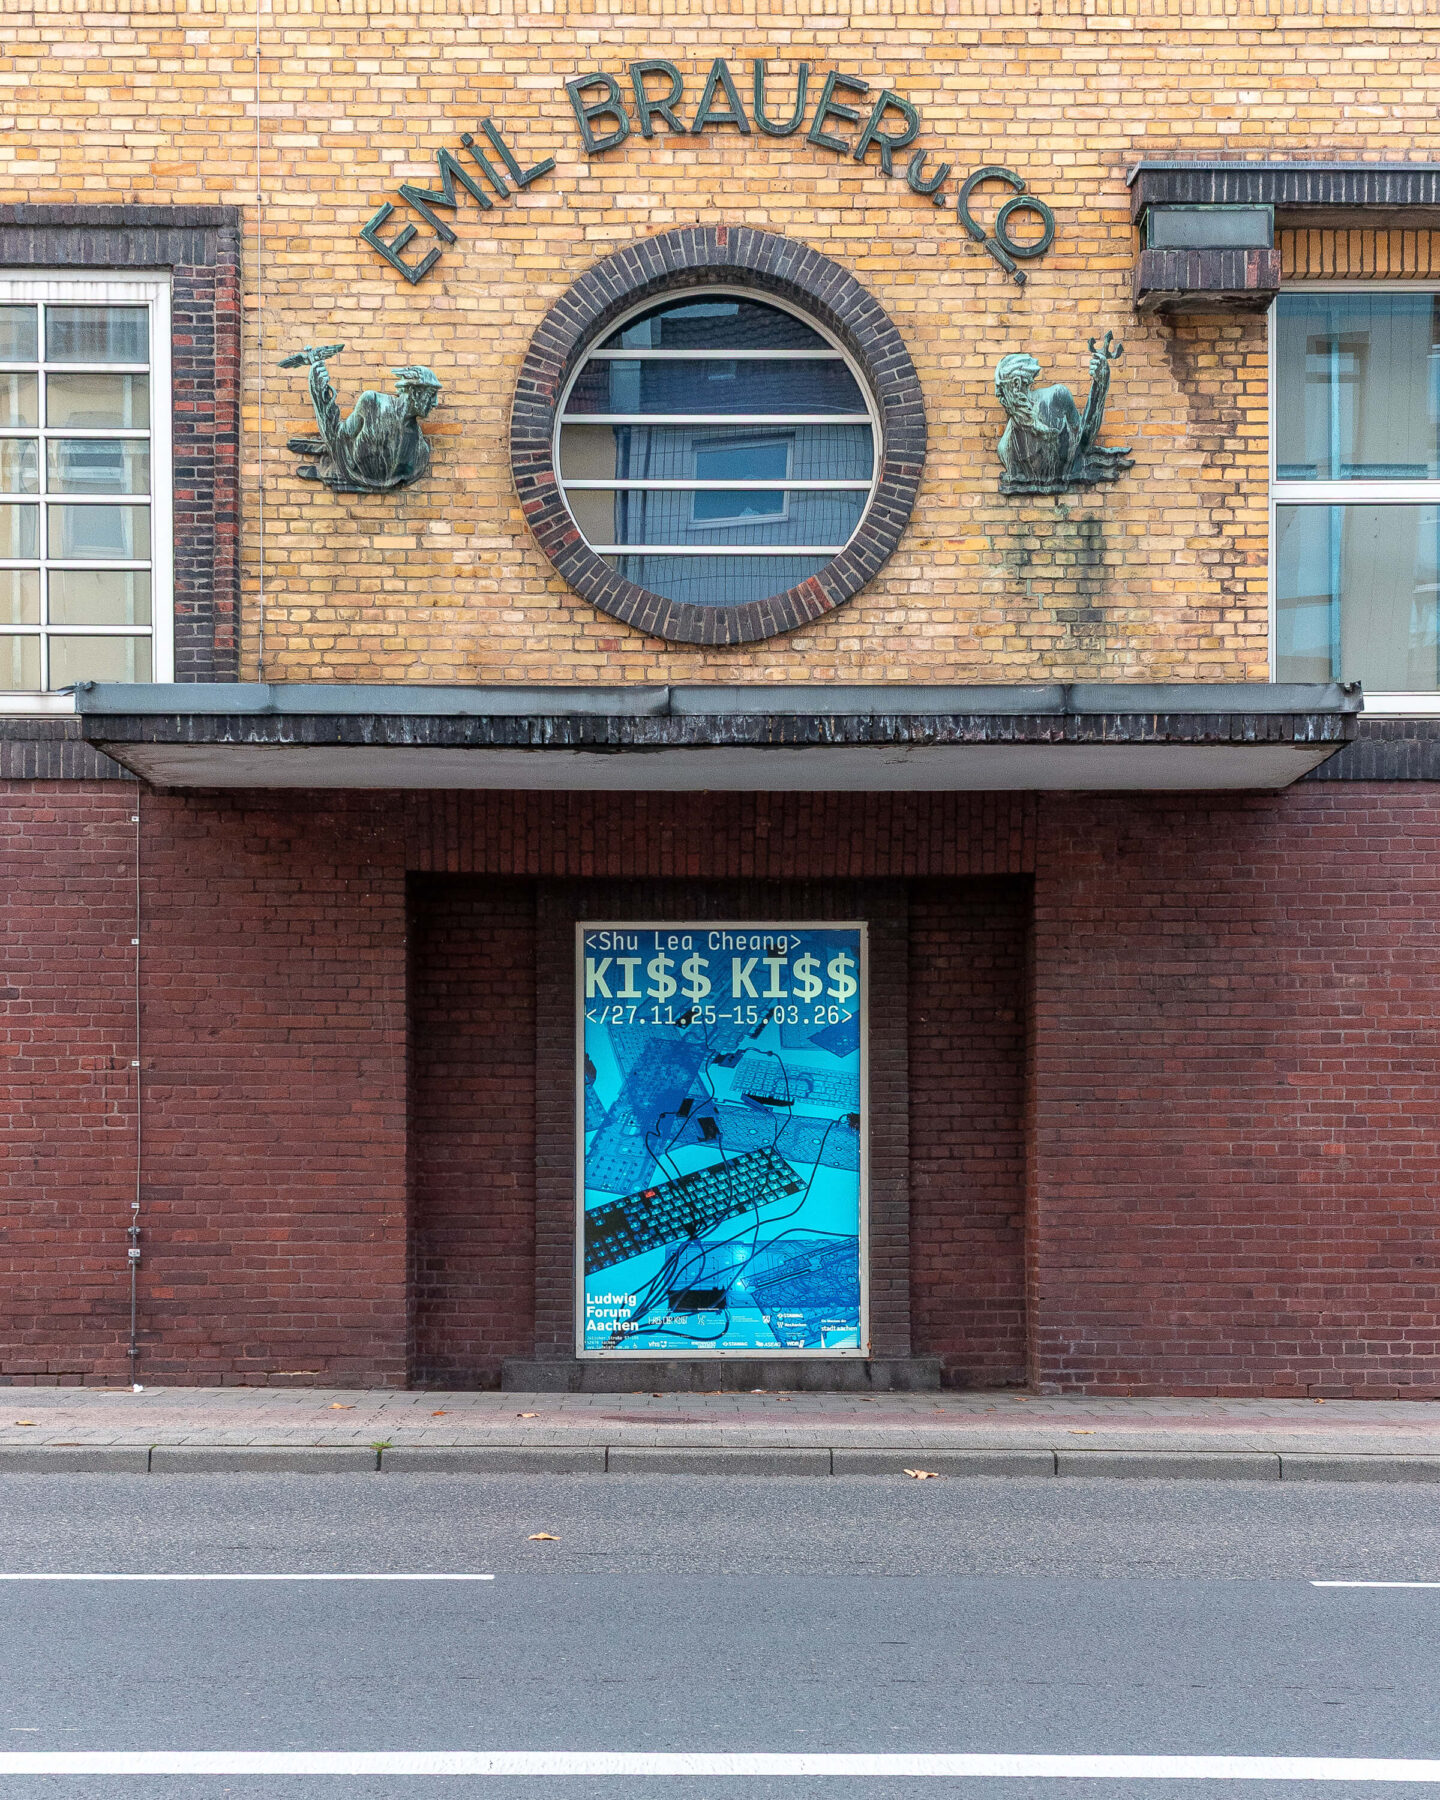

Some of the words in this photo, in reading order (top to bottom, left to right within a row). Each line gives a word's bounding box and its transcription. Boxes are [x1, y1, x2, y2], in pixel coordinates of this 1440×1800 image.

[565, 57, 920, 178] BRAUER
[585, 931, 638, 951] <Shu
[654, 931, 693, 951] Lea
[708, 931, 802, 955] Cheang>
[585, 953, 712, 1003] KI$$
[731, 953, 858, 1003] KI$$
[586, 1293, 637, 1307] Ludwig
[586, 1306, 631, 1318] Forum
[586, 1319, 639, 1331] Aachen
